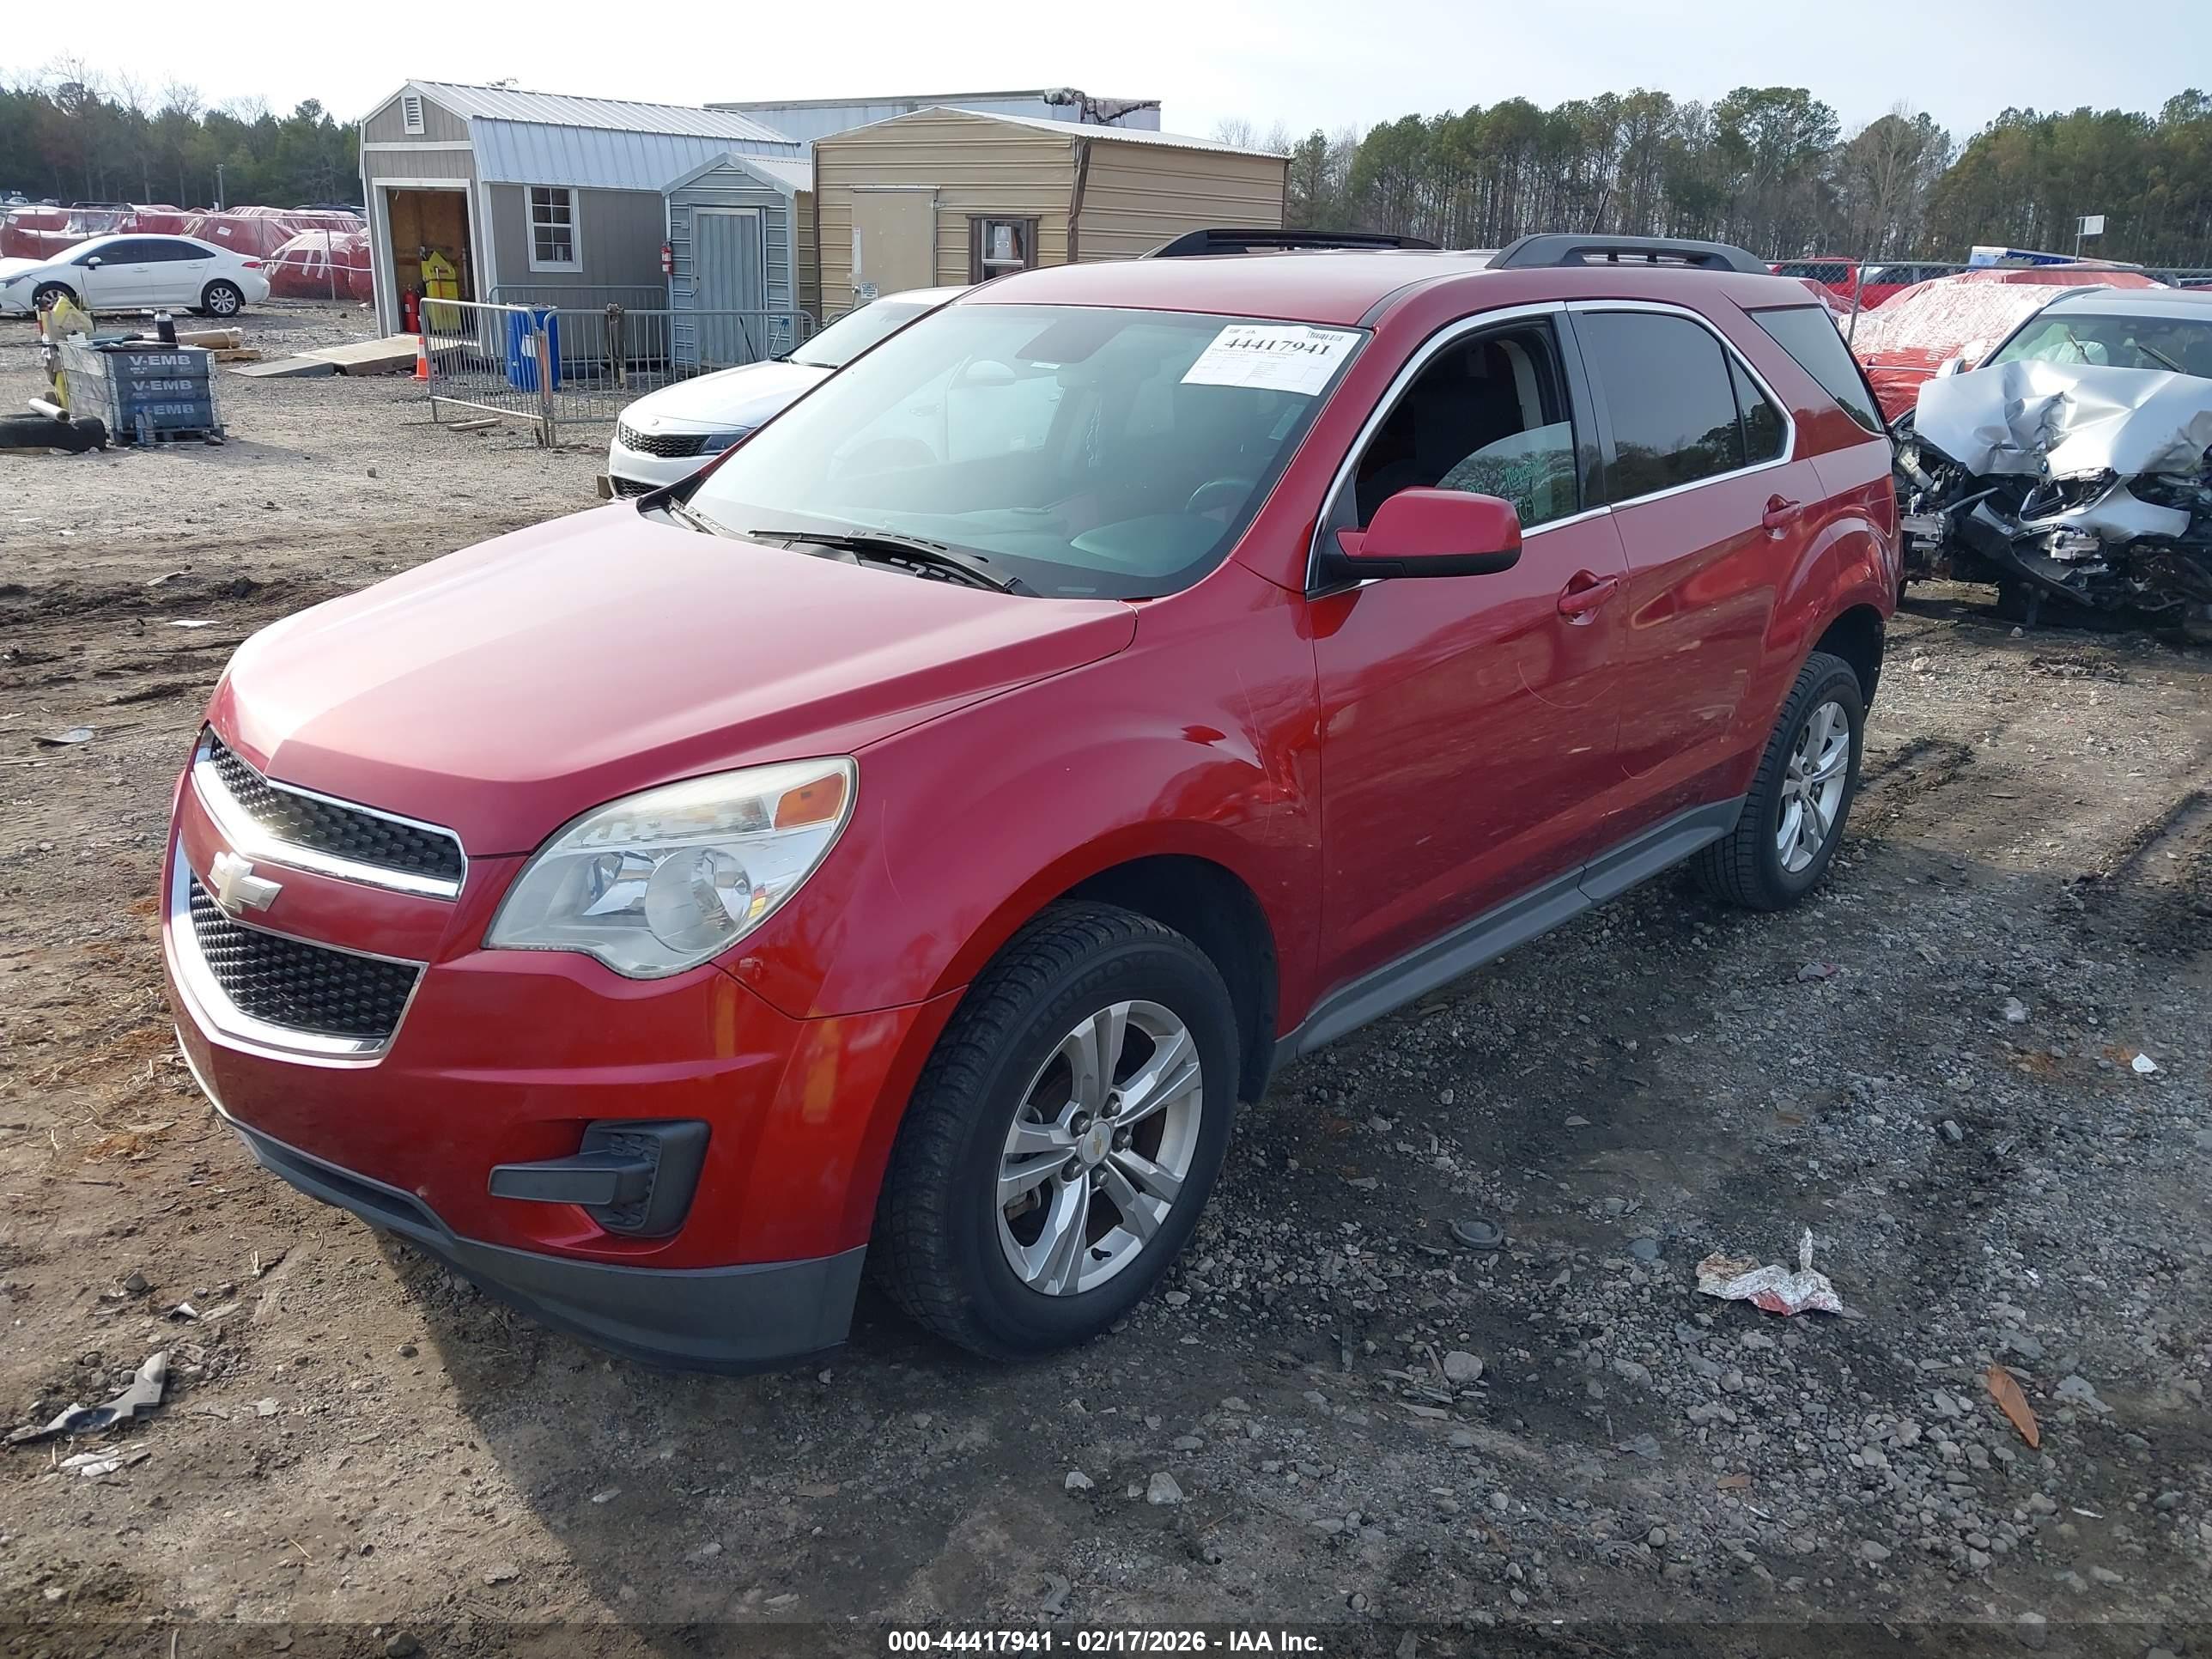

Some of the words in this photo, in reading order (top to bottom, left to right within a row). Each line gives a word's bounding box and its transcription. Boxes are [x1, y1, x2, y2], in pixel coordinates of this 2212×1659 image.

[1224, 337, 1331, 356] 44417941
[129, 355, 191, 366] V-EMB
[131, 380, 193, 391] V-EMB
